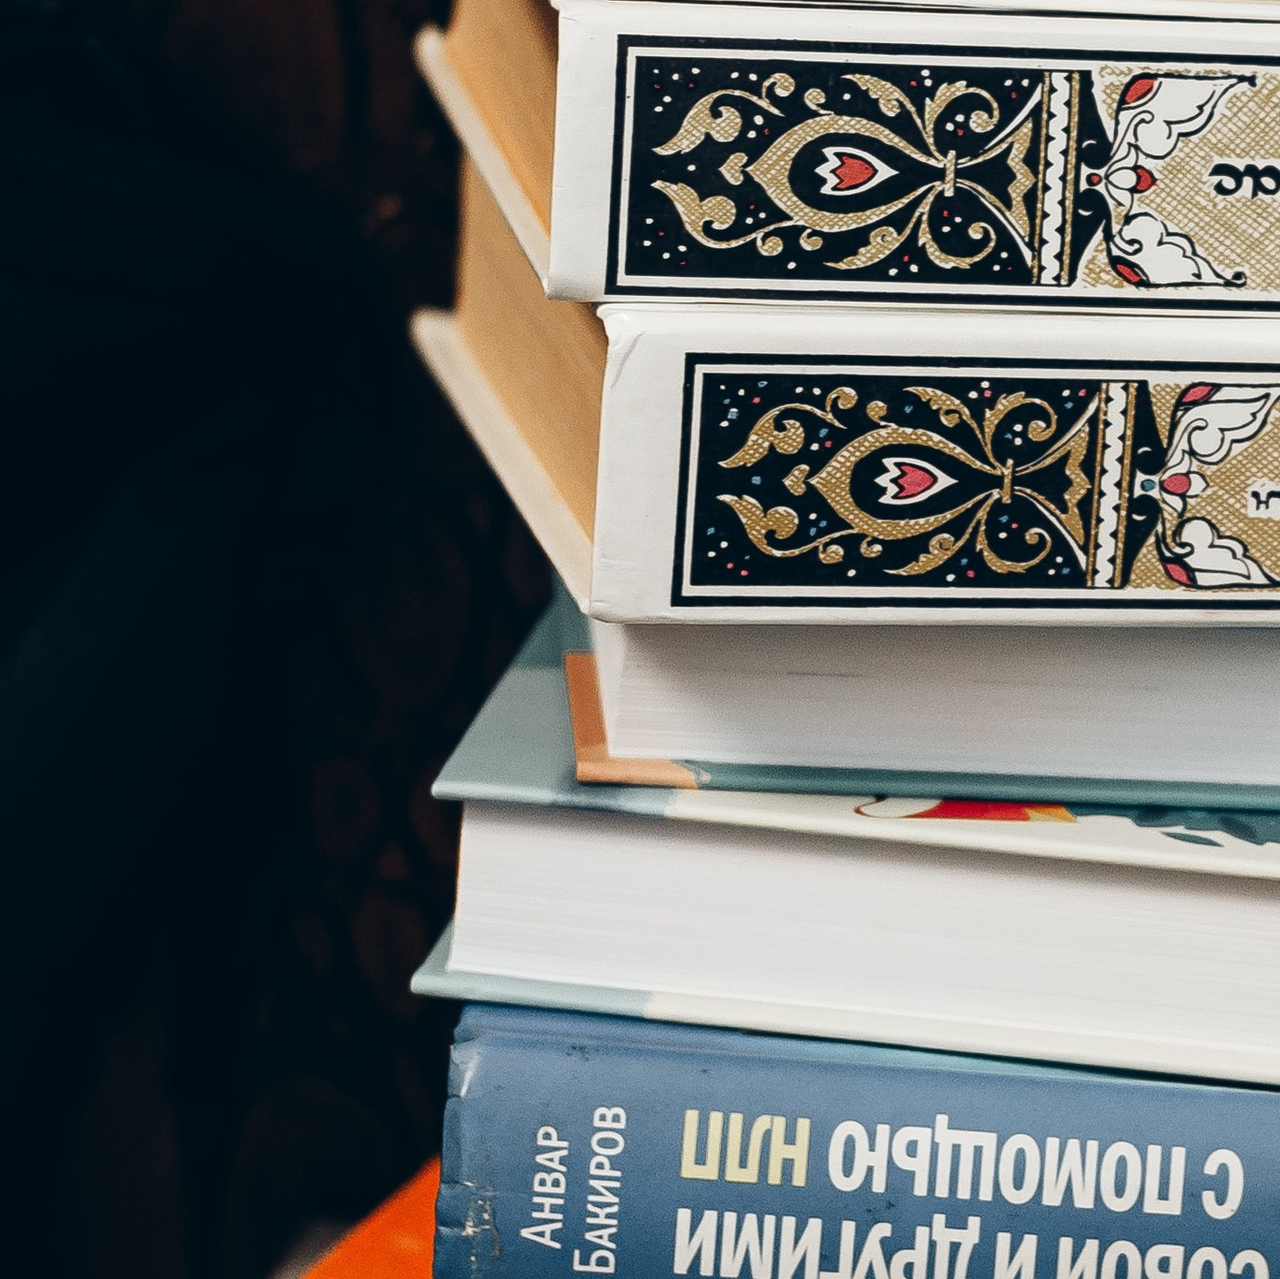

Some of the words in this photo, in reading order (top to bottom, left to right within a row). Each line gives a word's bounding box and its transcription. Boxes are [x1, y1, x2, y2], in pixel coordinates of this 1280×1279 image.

[519, 1123, 571, 1251] АНВАР
[572, 1104, 628, 1275] БАКИРОВ
[680, 1108, 812, 1188] НЛП
[828, 1113, 1188, 1216] ПОМОЩЬЮ
[1202, 1147, 1245, 1220] С
